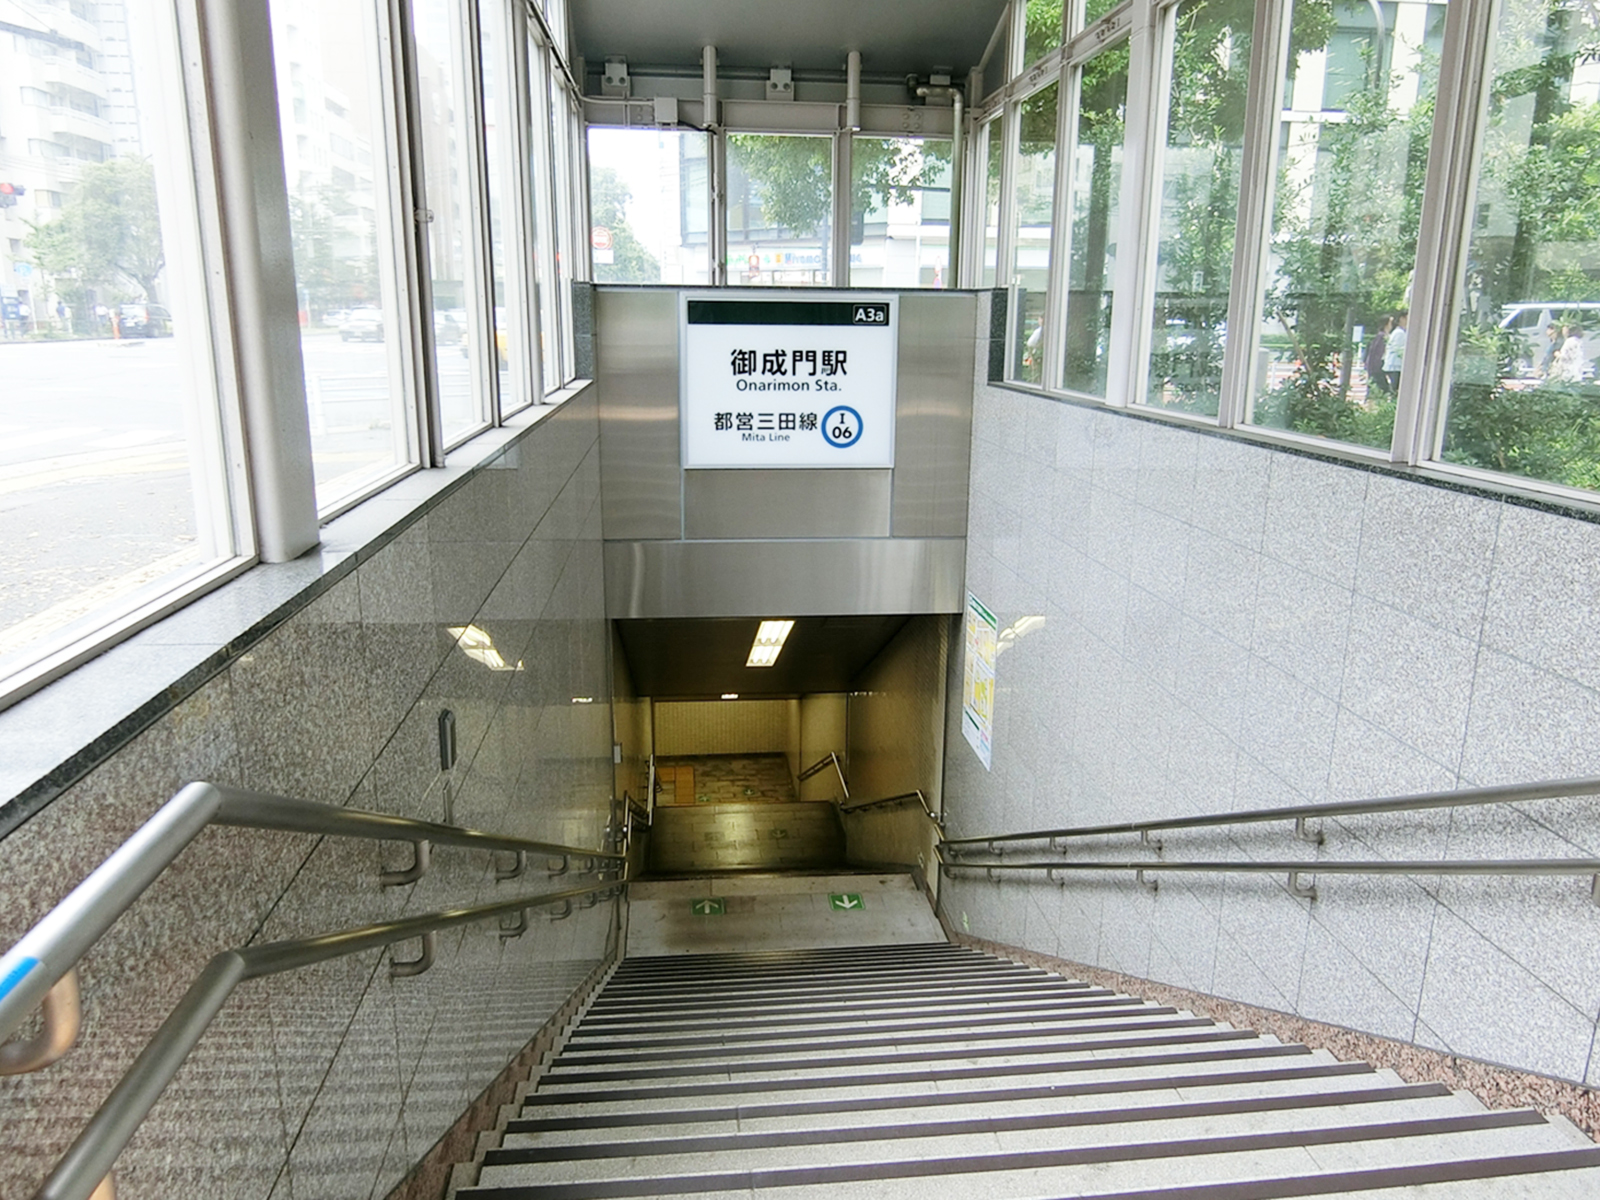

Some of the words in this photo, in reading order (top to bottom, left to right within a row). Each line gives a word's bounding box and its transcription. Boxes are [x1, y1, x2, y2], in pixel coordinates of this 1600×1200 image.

[854, 308, 884, 322] A3a
[730, 349, 848, 376] 御成門駅
[736, 379, 810, 391] Onarimon
[815, 379, 842, 391] Sta.
[714, 412, 818, 431] 都営三田線
[839, 413, 845, 425] I
[741, 432, 766, 442] Mita
[769, 432, 790, 442] Line
[832, 426, 853, 439] 06
